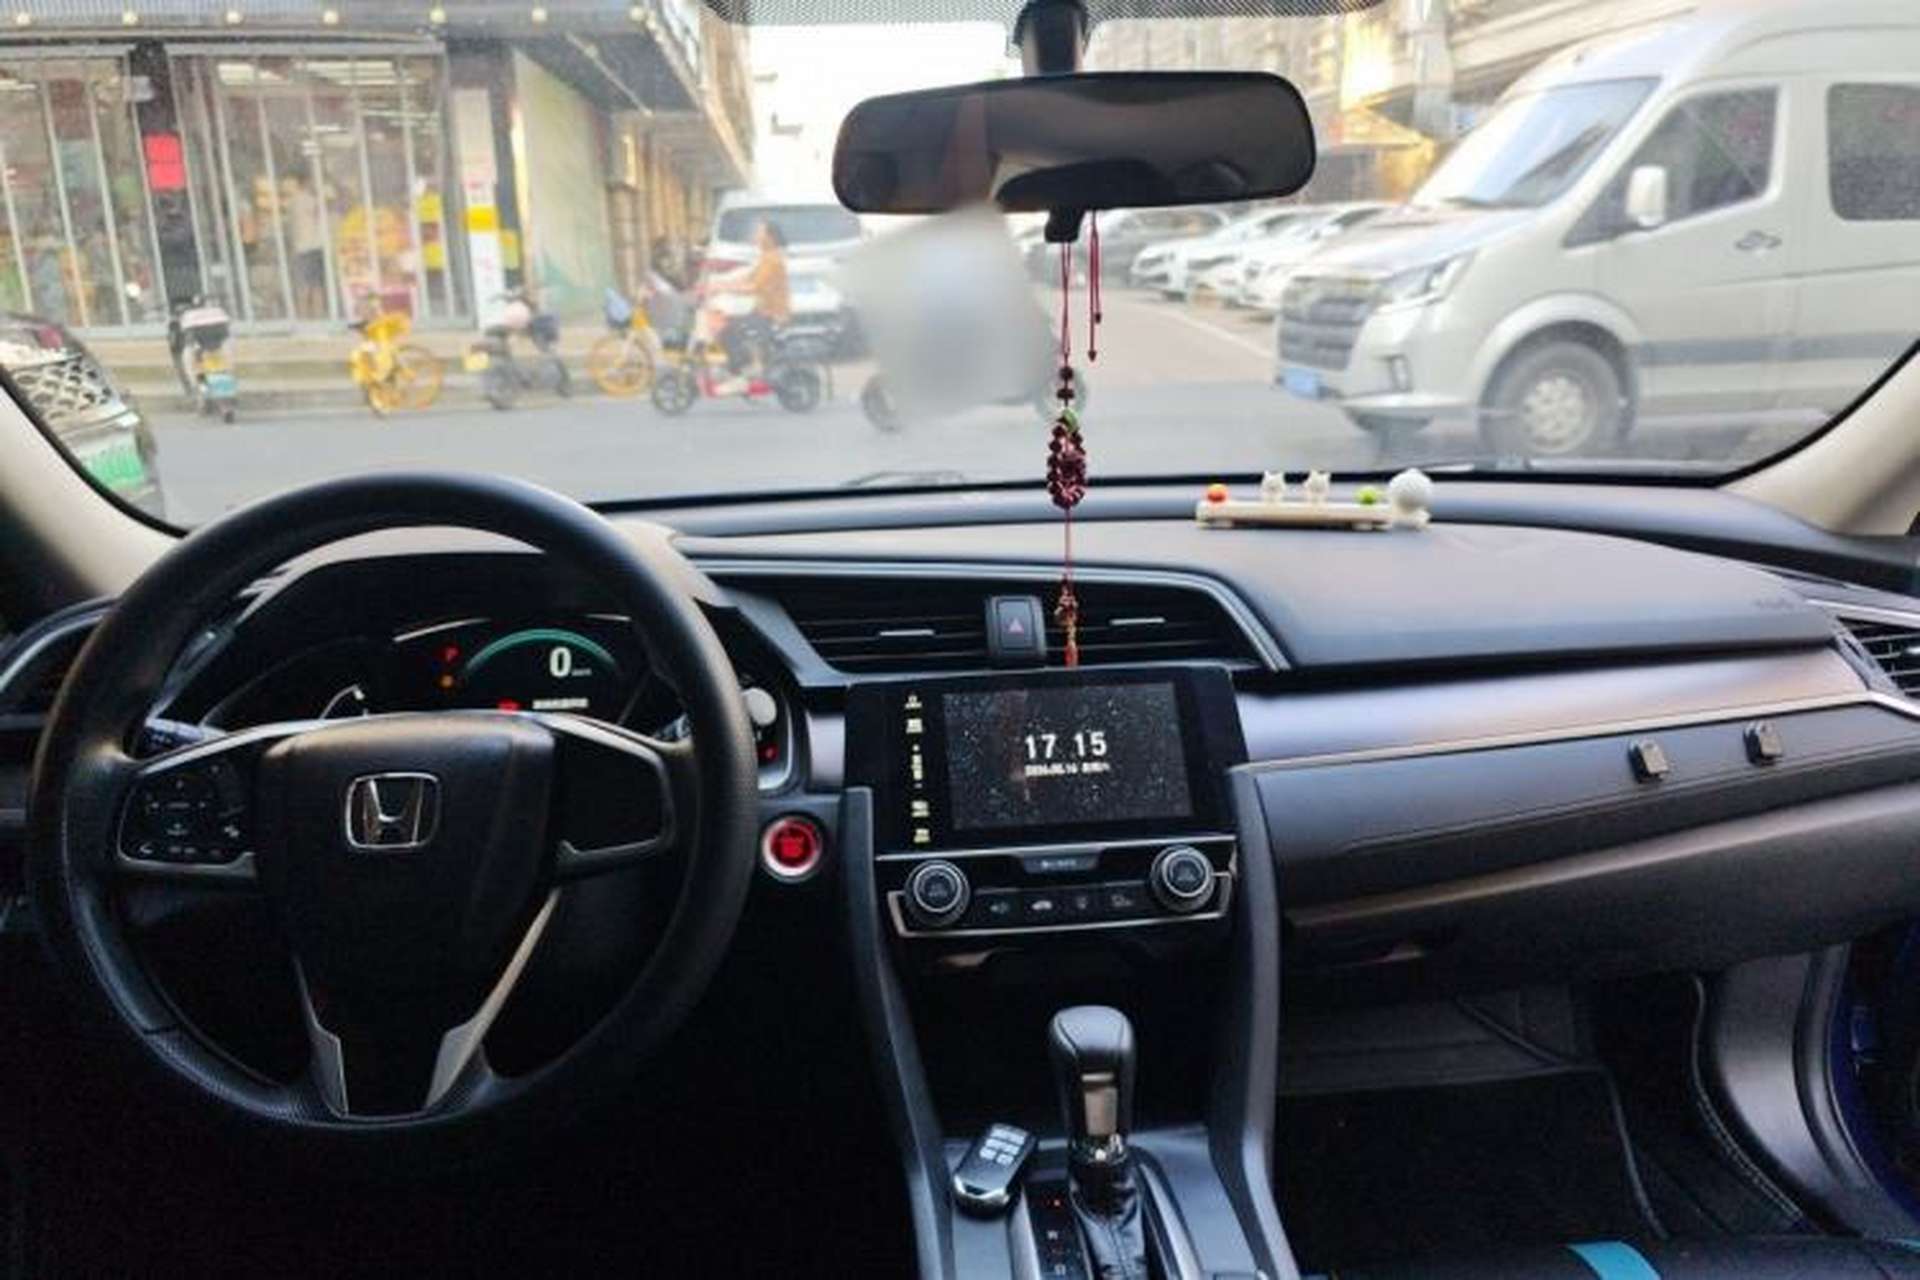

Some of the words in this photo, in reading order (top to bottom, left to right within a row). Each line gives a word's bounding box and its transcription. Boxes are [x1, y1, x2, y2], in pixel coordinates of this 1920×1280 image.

[550, 646, 572, 677] 0
[1025, 734, 1056, 759] 17
[1075, 731, 1107, 756] 15
